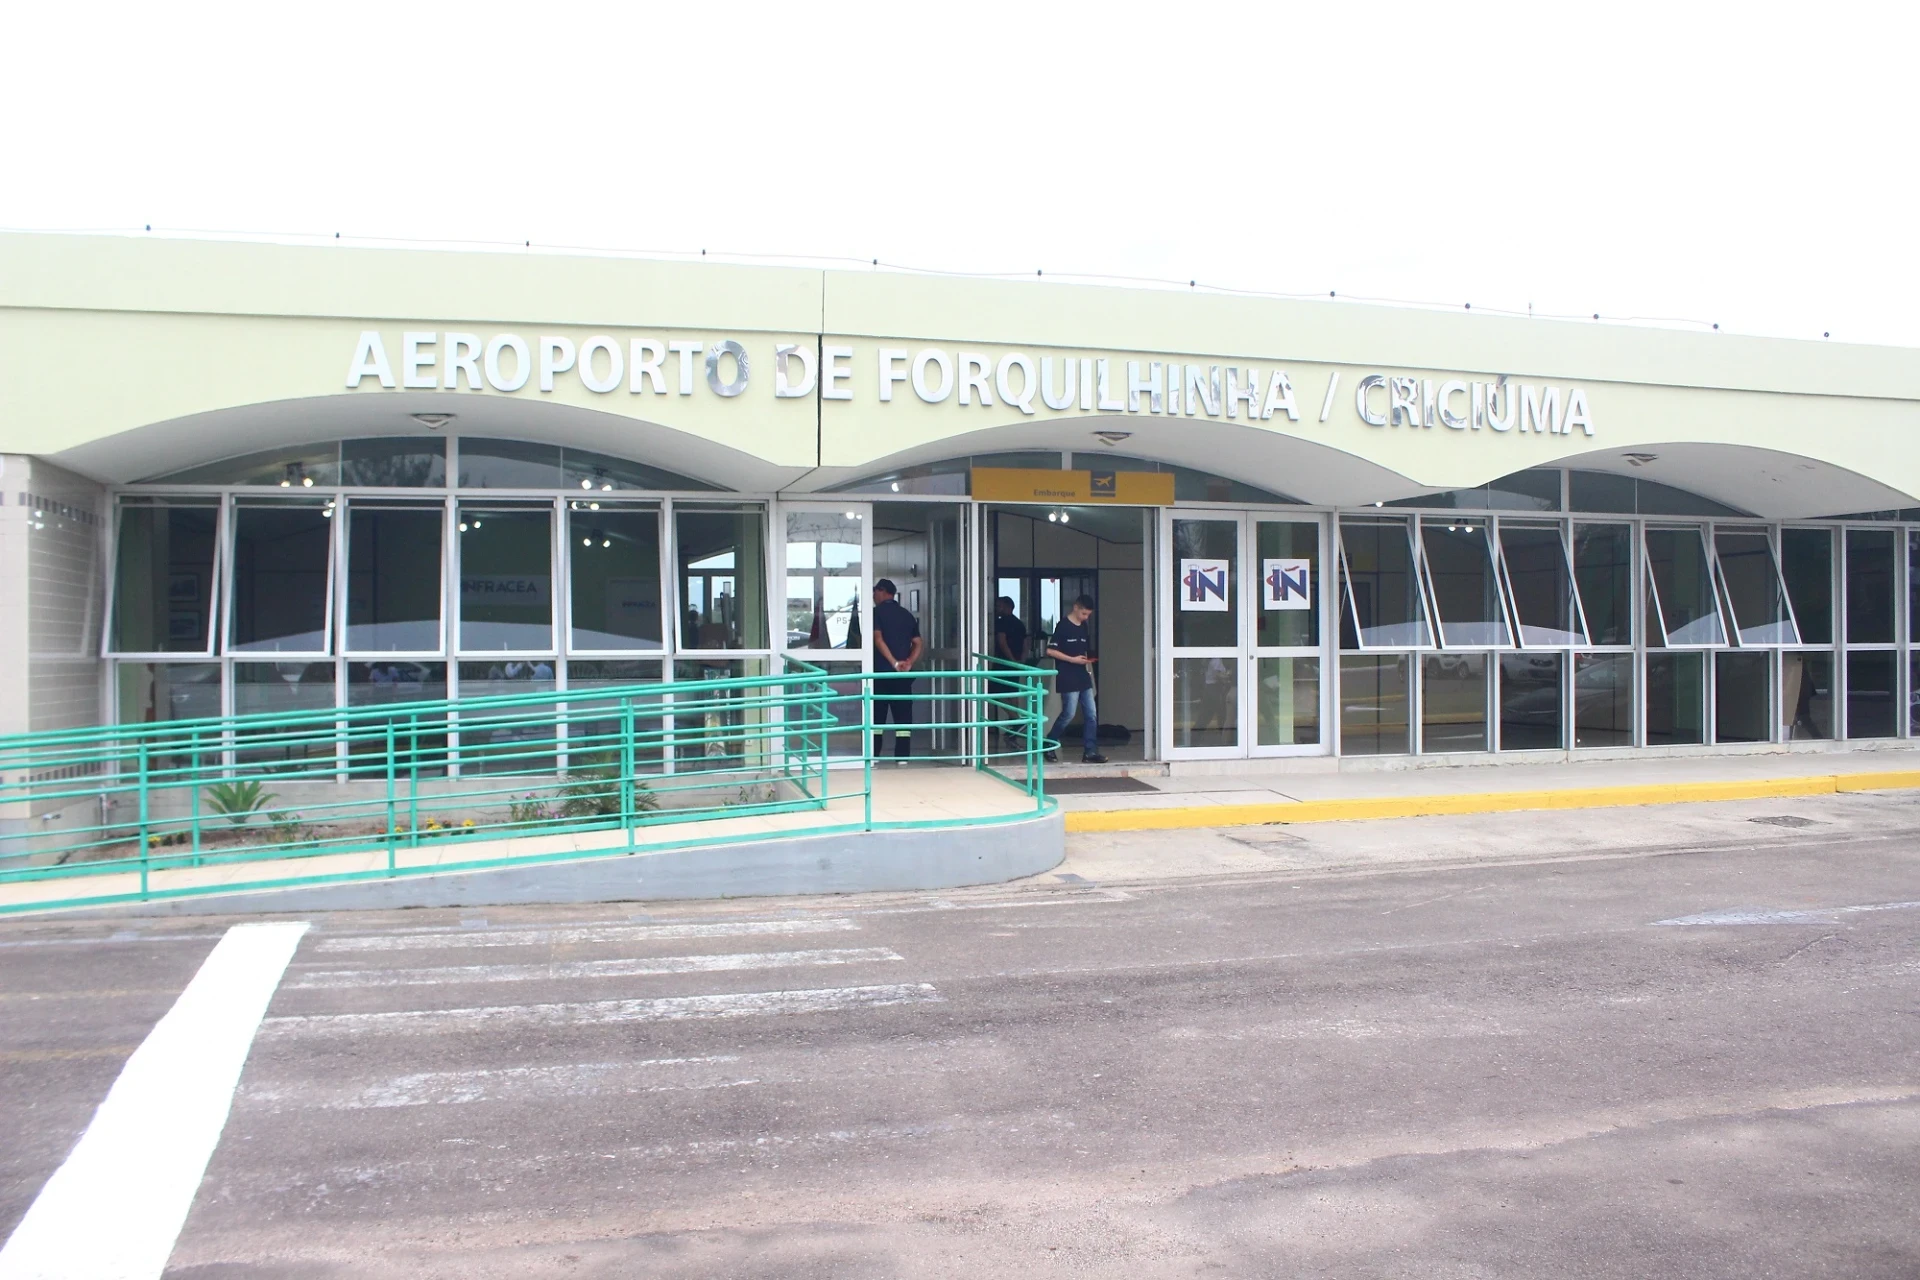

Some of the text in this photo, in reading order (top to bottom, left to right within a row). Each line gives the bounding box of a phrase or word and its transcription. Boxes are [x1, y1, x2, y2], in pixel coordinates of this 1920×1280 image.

[345, 330, 1596, 437] AEROPORTO DE FORQUILHINHA / CRICIÚMA
[1033, 488, 1076, 499] Embarque
